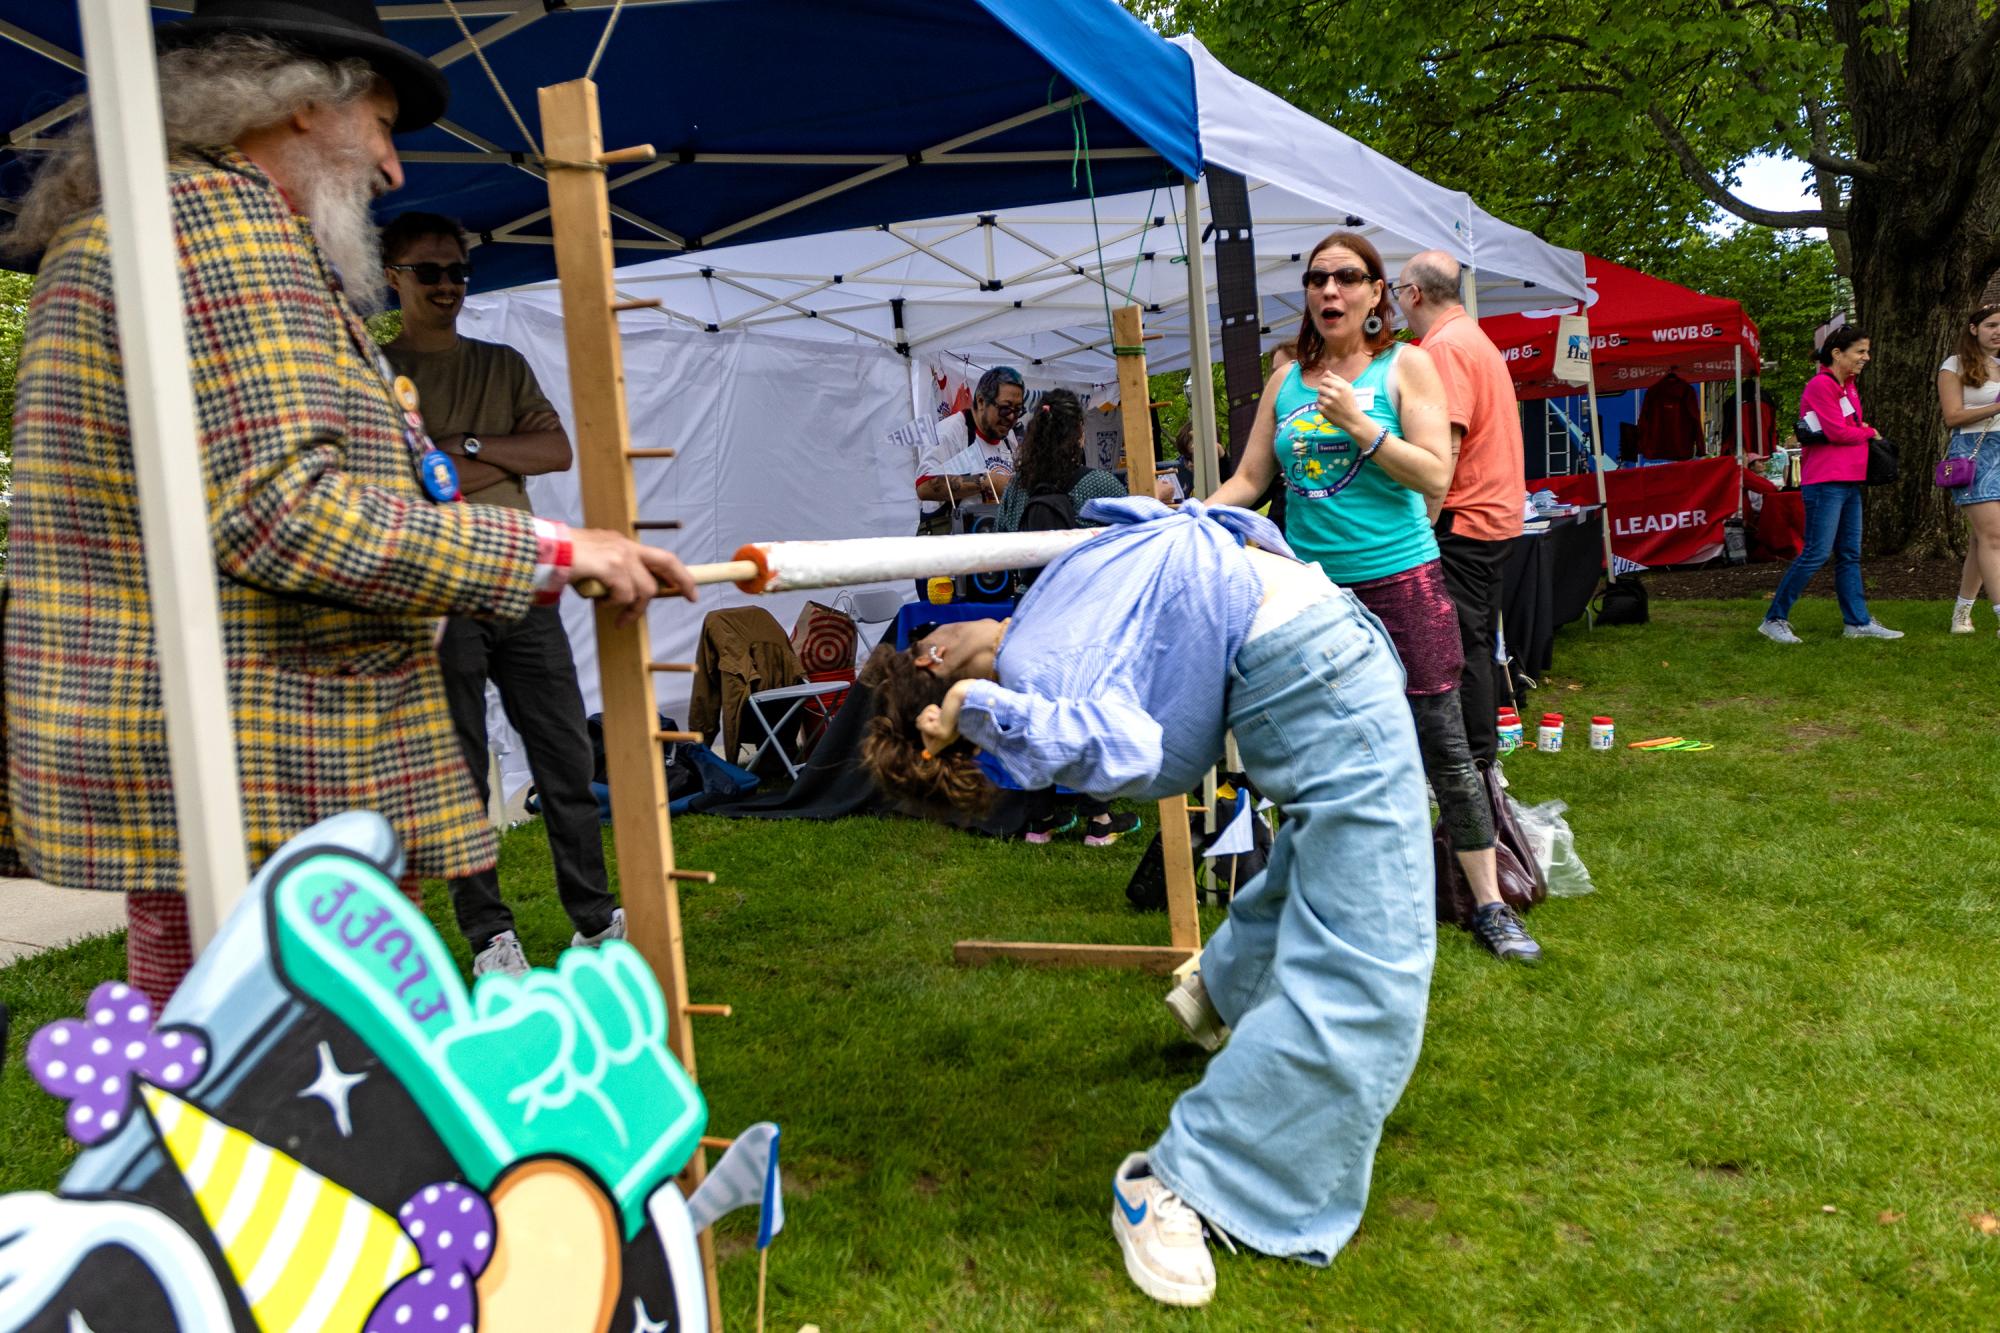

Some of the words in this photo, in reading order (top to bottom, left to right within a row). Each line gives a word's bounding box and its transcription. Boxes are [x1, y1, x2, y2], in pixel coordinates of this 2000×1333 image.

[1652, 326, 1699, 343] WCVB
[1308, 490, 1328, 498] 2021
[1615, 509, 1708, 536] LEADER
